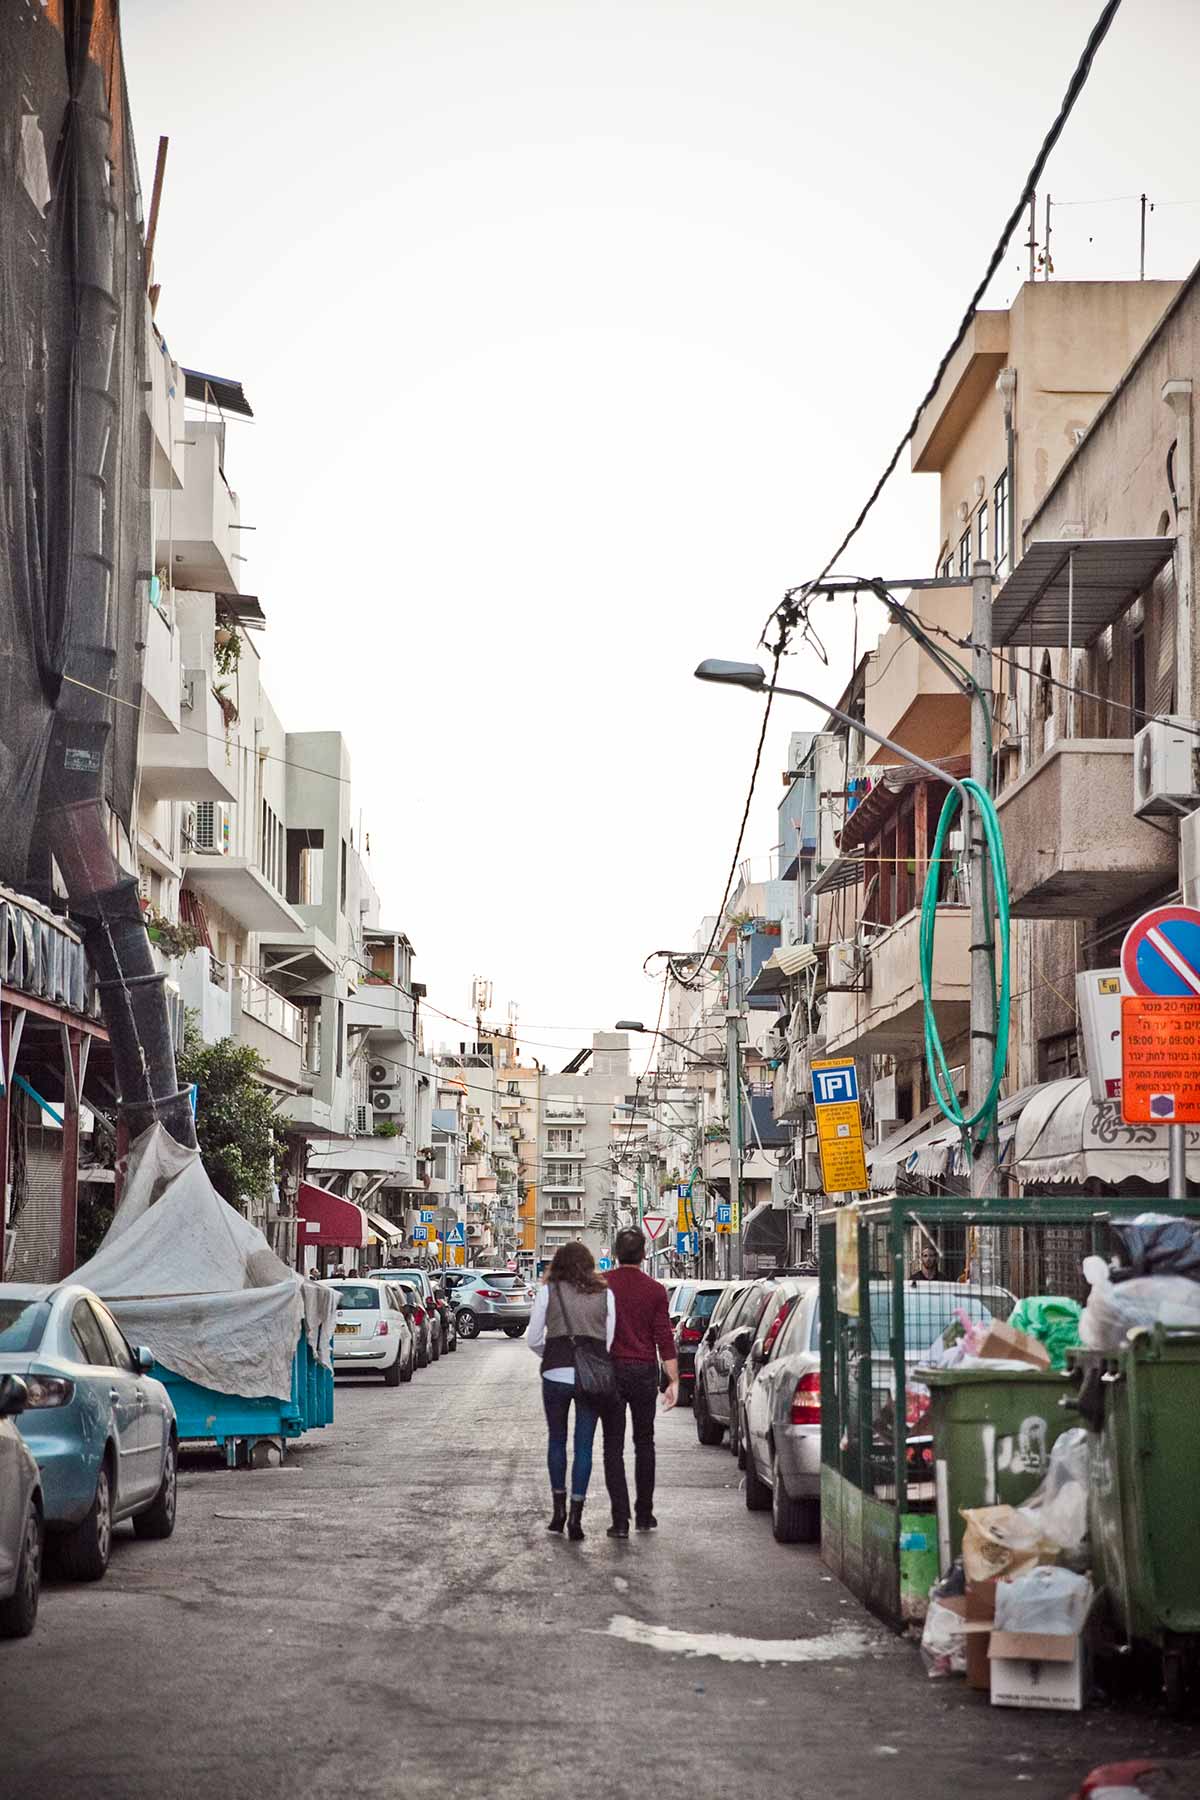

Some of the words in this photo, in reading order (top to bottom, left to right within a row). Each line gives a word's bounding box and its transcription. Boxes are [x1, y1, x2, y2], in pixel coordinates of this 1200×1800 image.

[1141, 1002, 1162, 1012] מטר
[1164, 1002, 1177, 1011] 20
[1128, 1035, 1153, 1045] 15:00
[1154, 1036, 1166, 1046] עד
